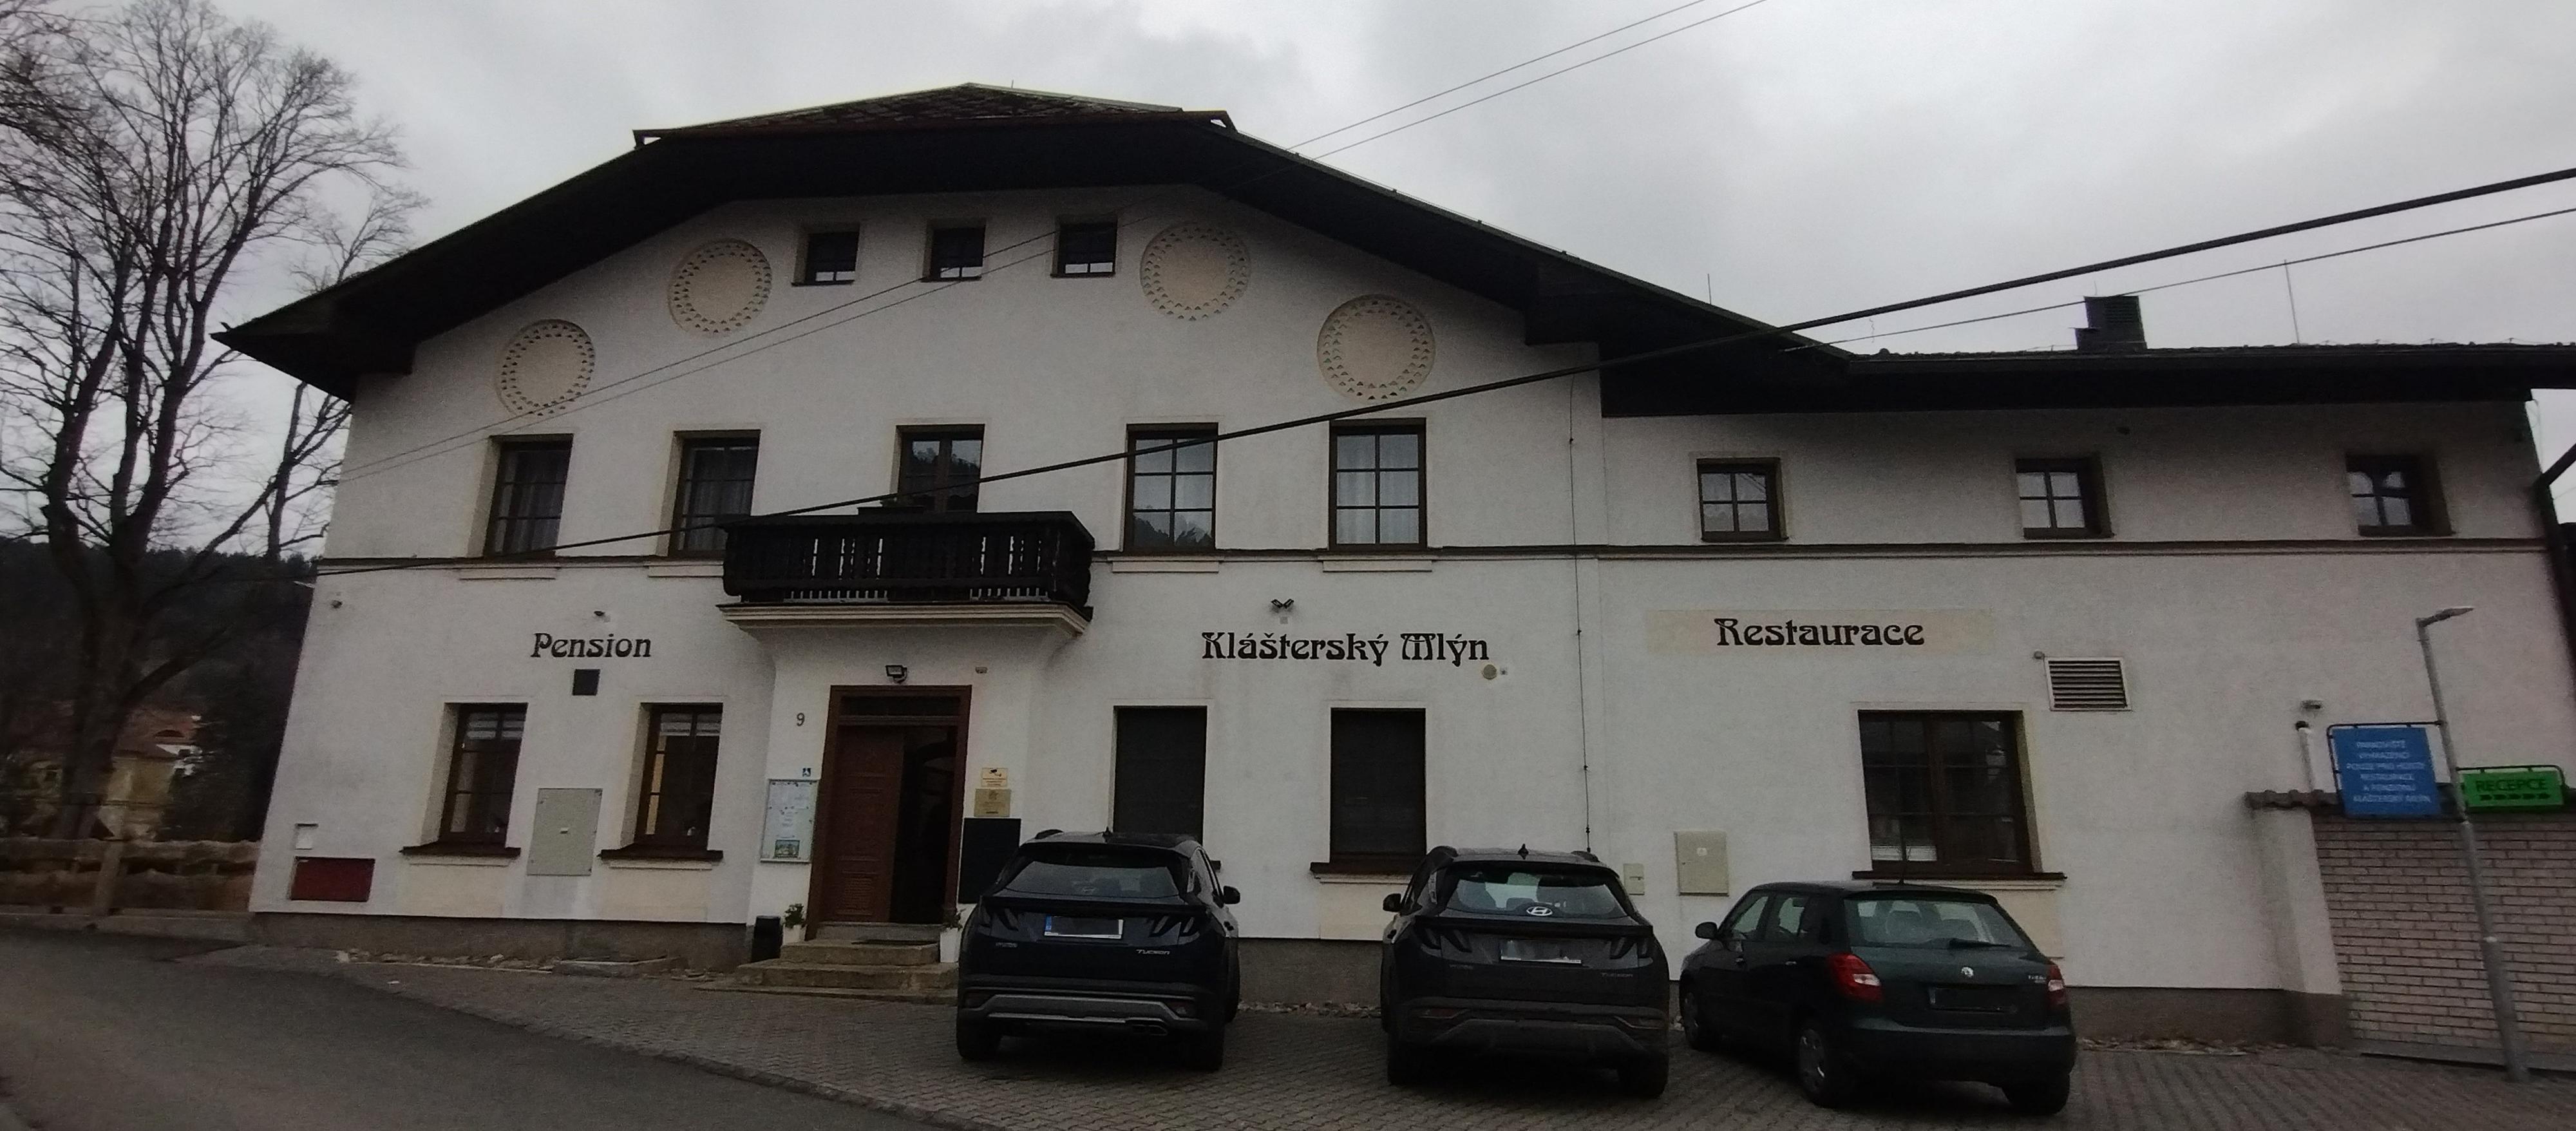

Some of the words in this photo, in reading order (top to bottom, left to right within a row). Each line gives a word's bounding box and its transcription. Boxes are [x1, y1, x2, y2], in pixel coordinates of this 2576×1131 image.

[530, 632, 652, 658] Pension
[1714, 618, 1925, 646] Restaurace
[1201, 632, 1389, 667] Klášterský
[1400, 632, 1490, 667] Mlýn
[796, 712, 805, 727] 9
[2476, 779, 2548, 792] RECEPCE
